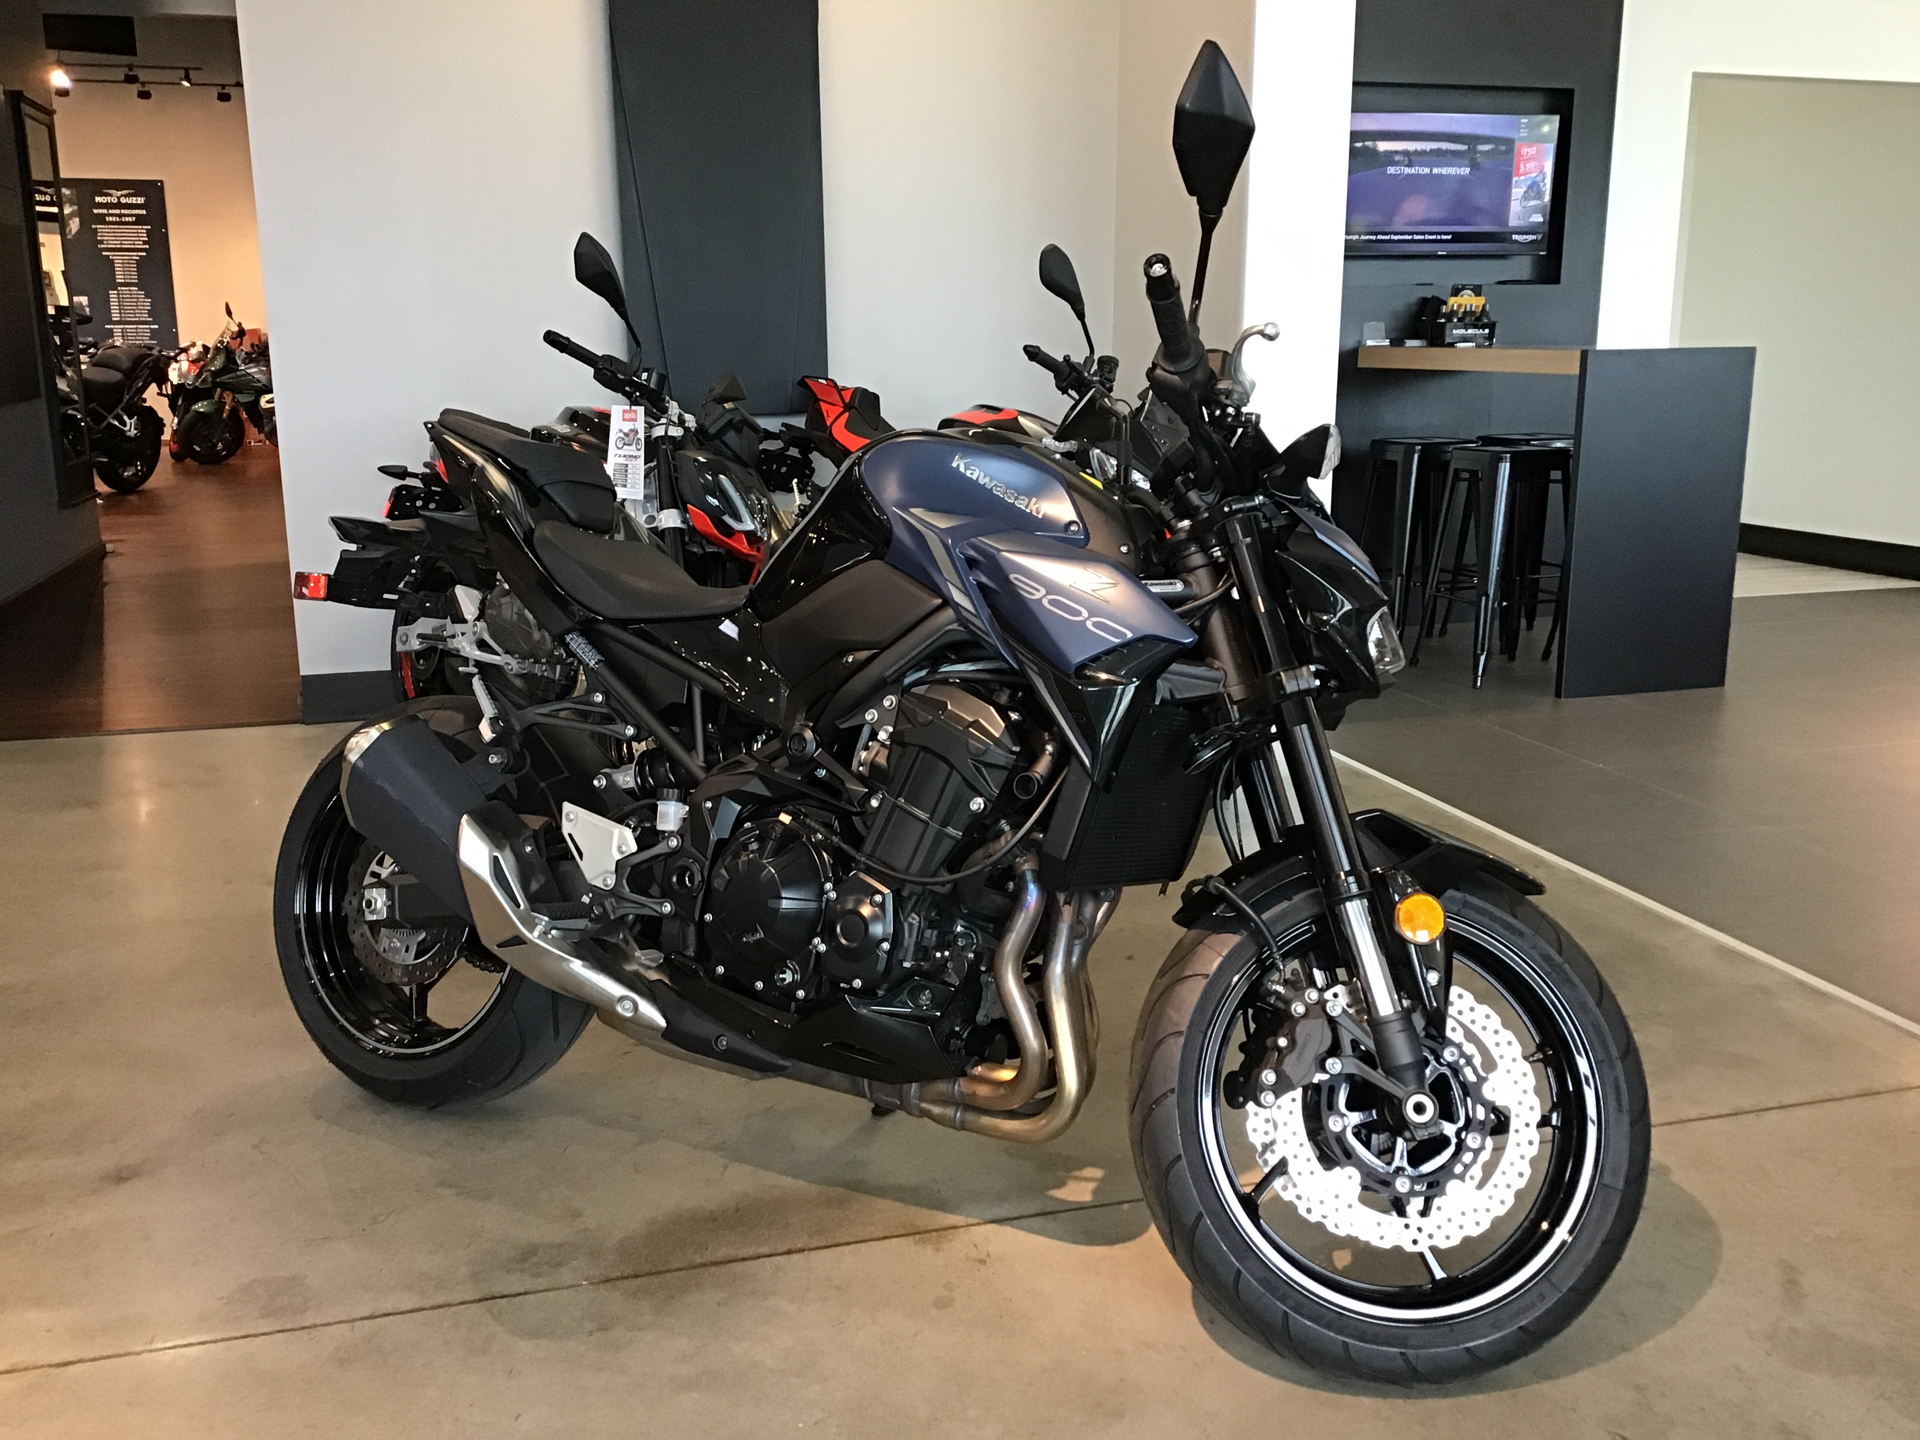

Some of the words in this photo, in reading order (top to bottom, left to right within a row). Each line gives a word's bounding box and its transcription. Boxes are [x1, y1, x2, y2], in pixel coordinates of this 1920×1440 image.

[1387, 166, 1430, 175] DESTINATION
[1432, 167, 1471, 175] WHEREVER
[1512, 234, 1537, 242] TRIUMPH
[951, 452, 1046, 519] Kawasaki
